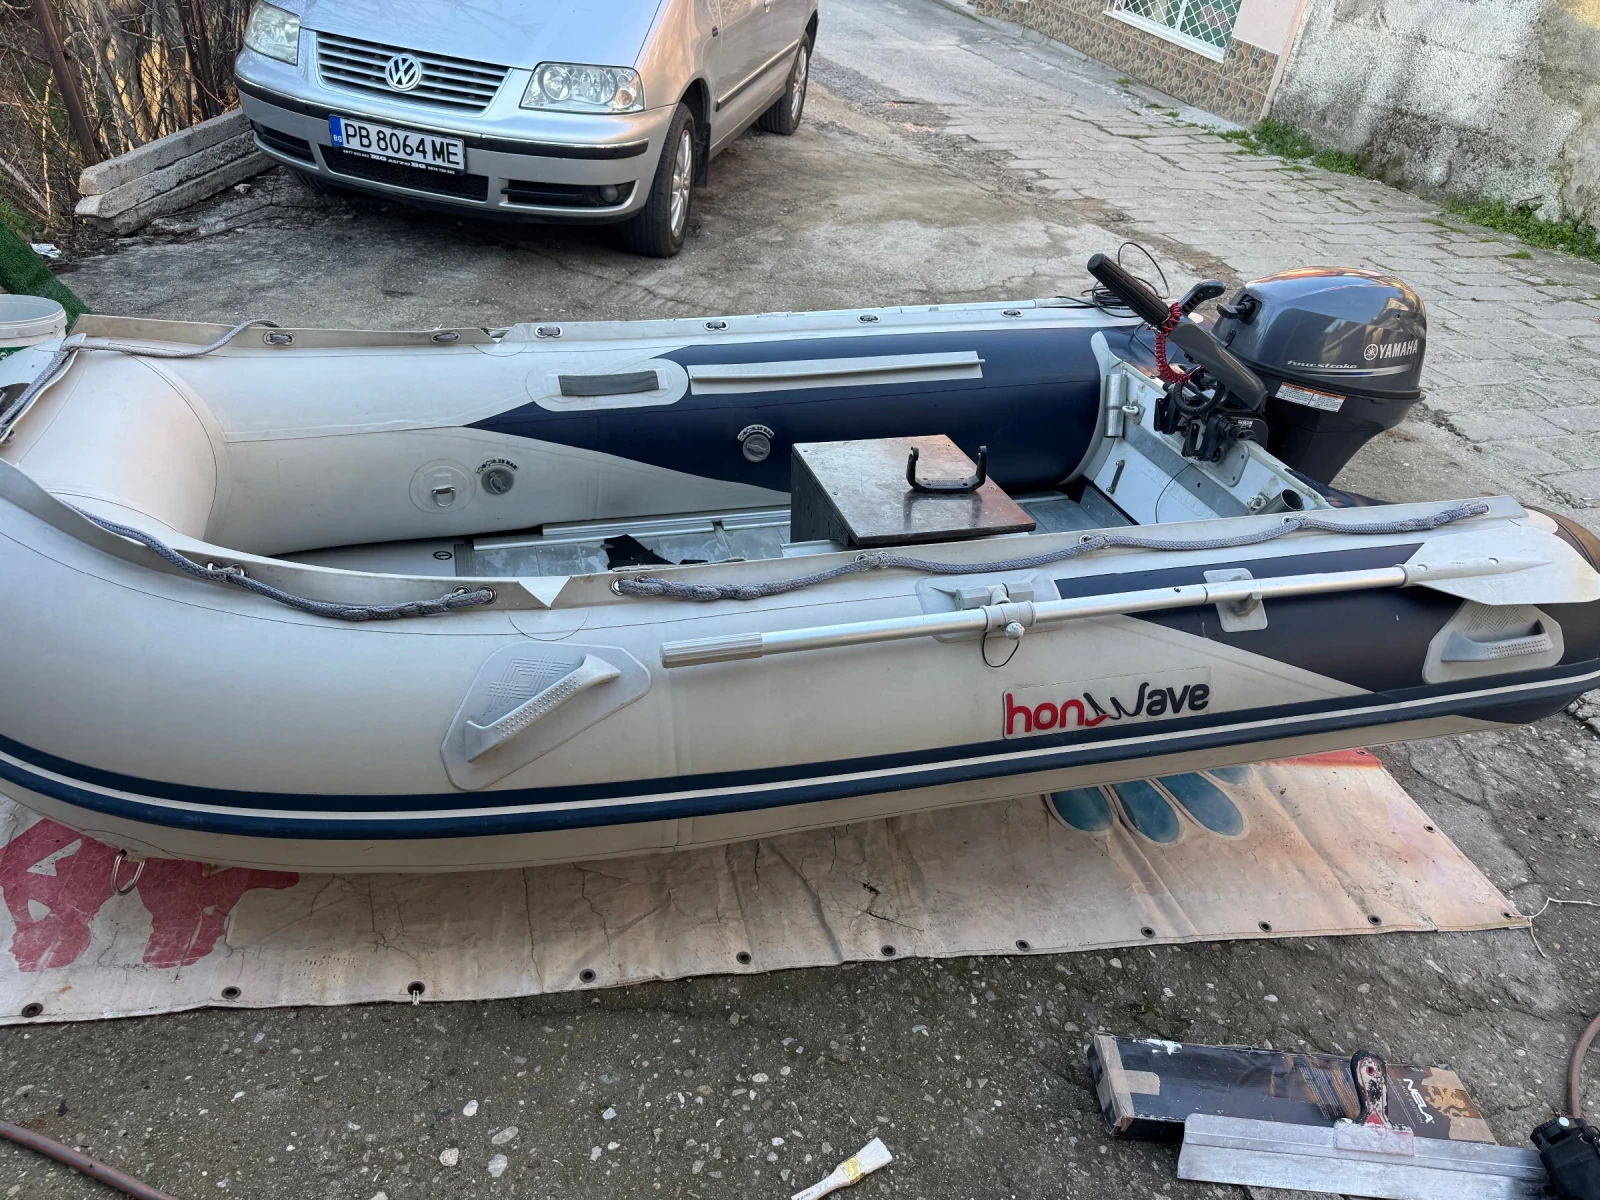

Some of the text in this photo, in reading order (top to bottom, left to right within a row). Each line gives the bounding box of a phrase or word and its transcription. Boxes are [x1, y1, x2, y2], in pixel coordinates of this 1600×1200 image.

[333, 134, 343, 143] BG
[344, 122, 460, 165] PB 8064 ME
[1379, 339, 1418, 359] YAMAHA
[506, 460, 518, 470] BAR
[1402, 1078, 1434, 1124] NELA
